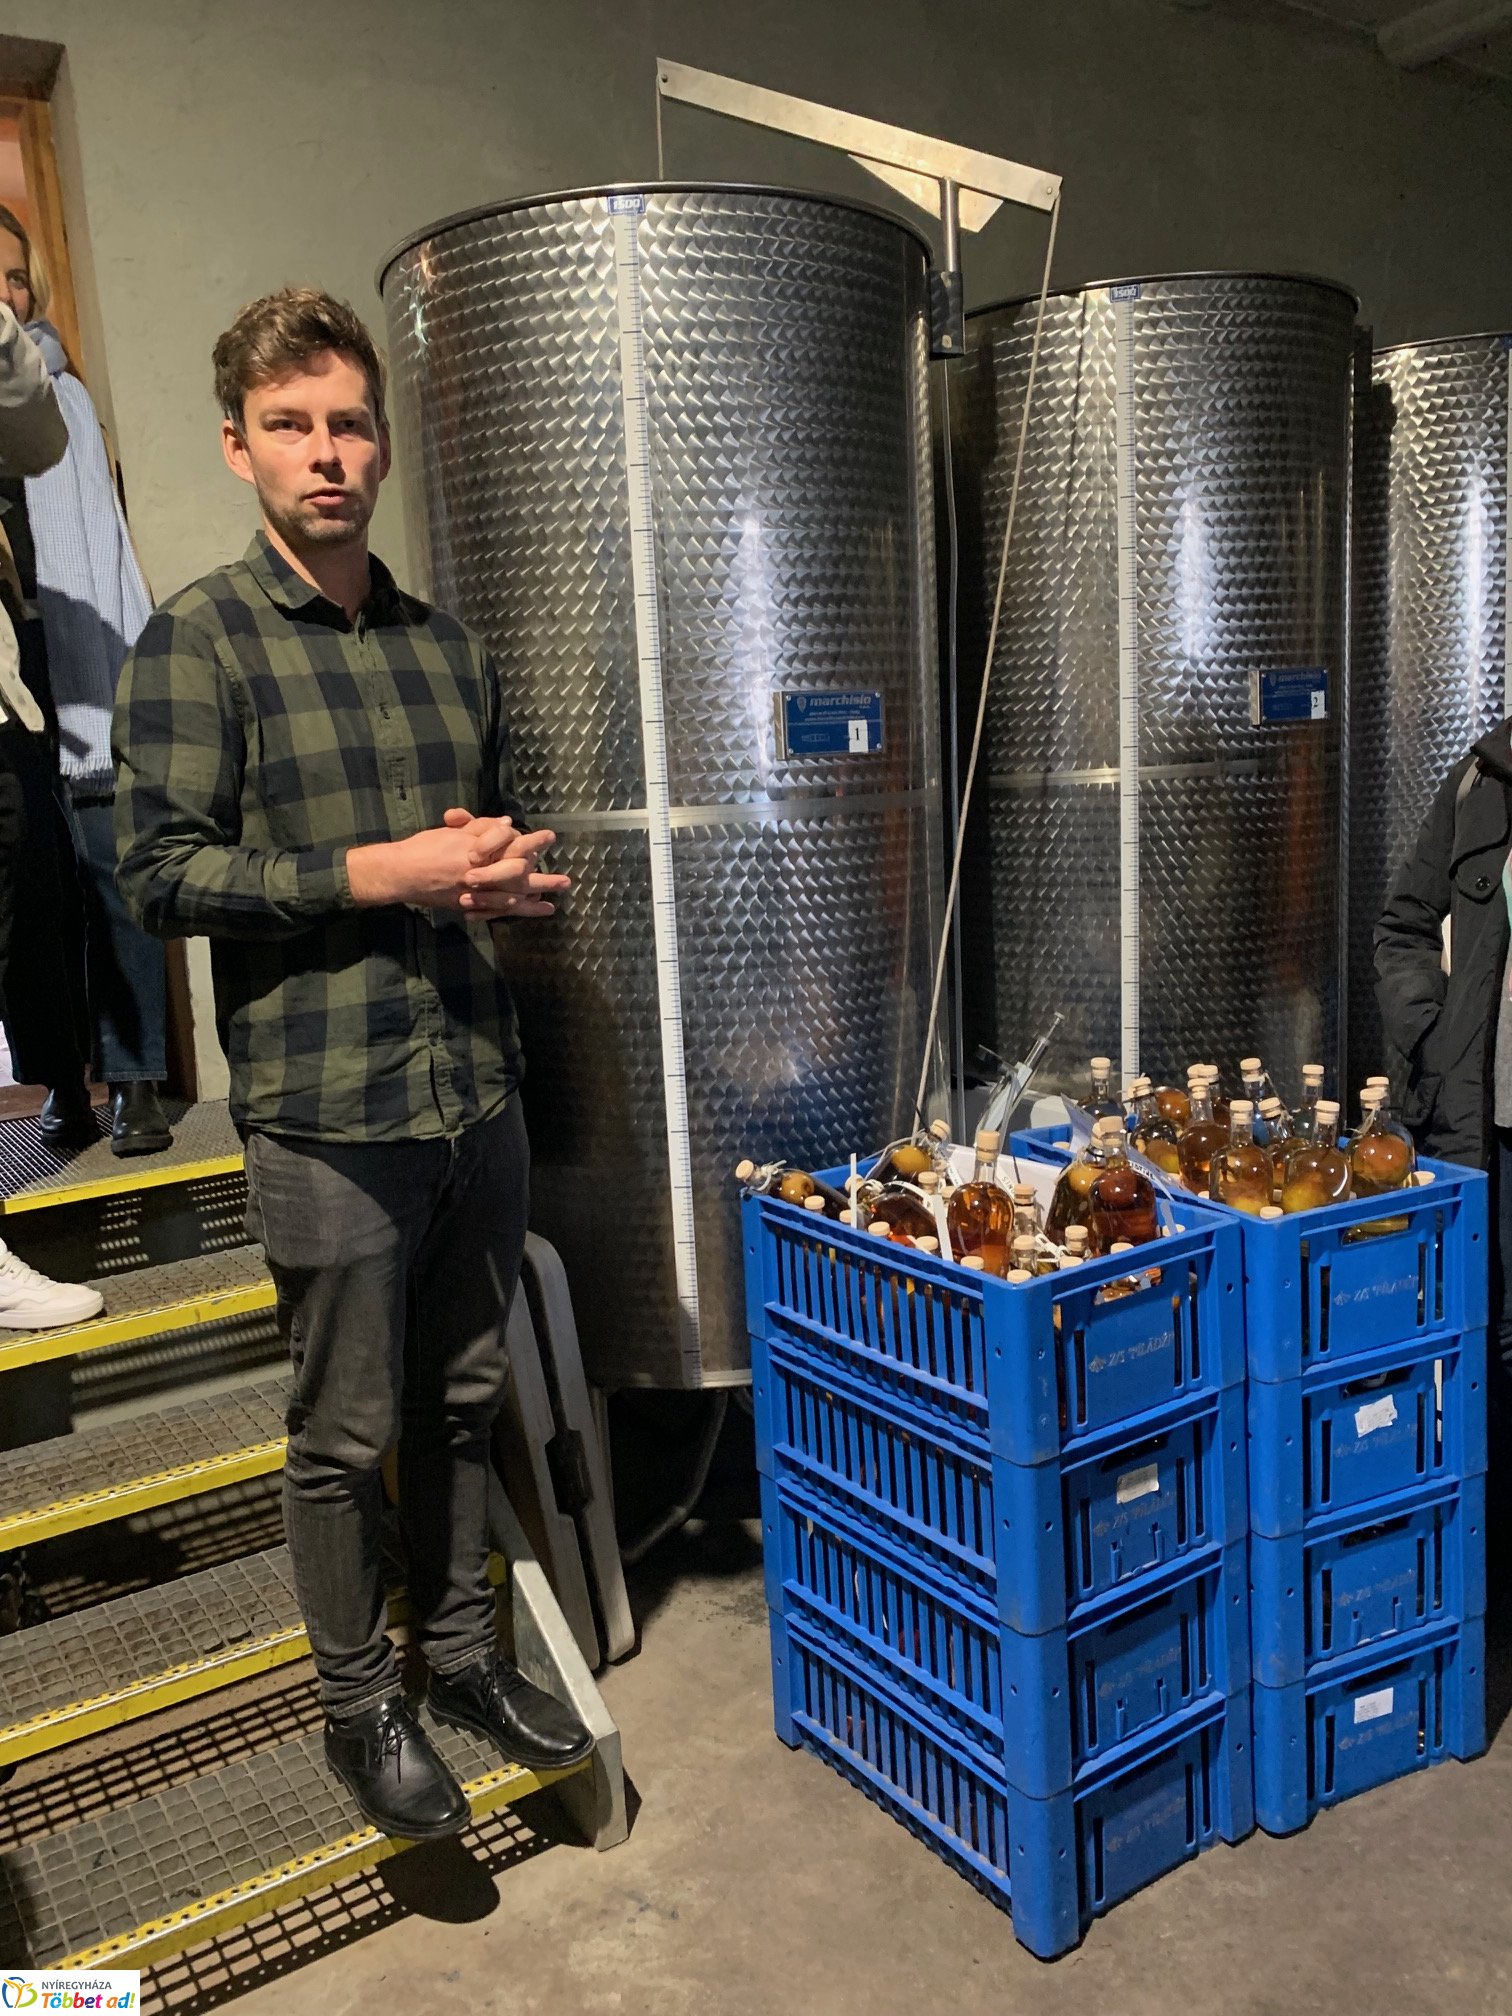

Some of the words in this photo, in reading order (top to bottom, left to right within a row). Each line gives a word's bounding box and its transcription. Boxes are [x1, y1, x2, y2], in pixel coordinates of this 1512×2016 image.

[613, 198, 640, 210] 1500
[809, 694, 872, 707] marchisio
[1312, 696, 1319, 708] 2
[855, 727, 860, 741] 1
